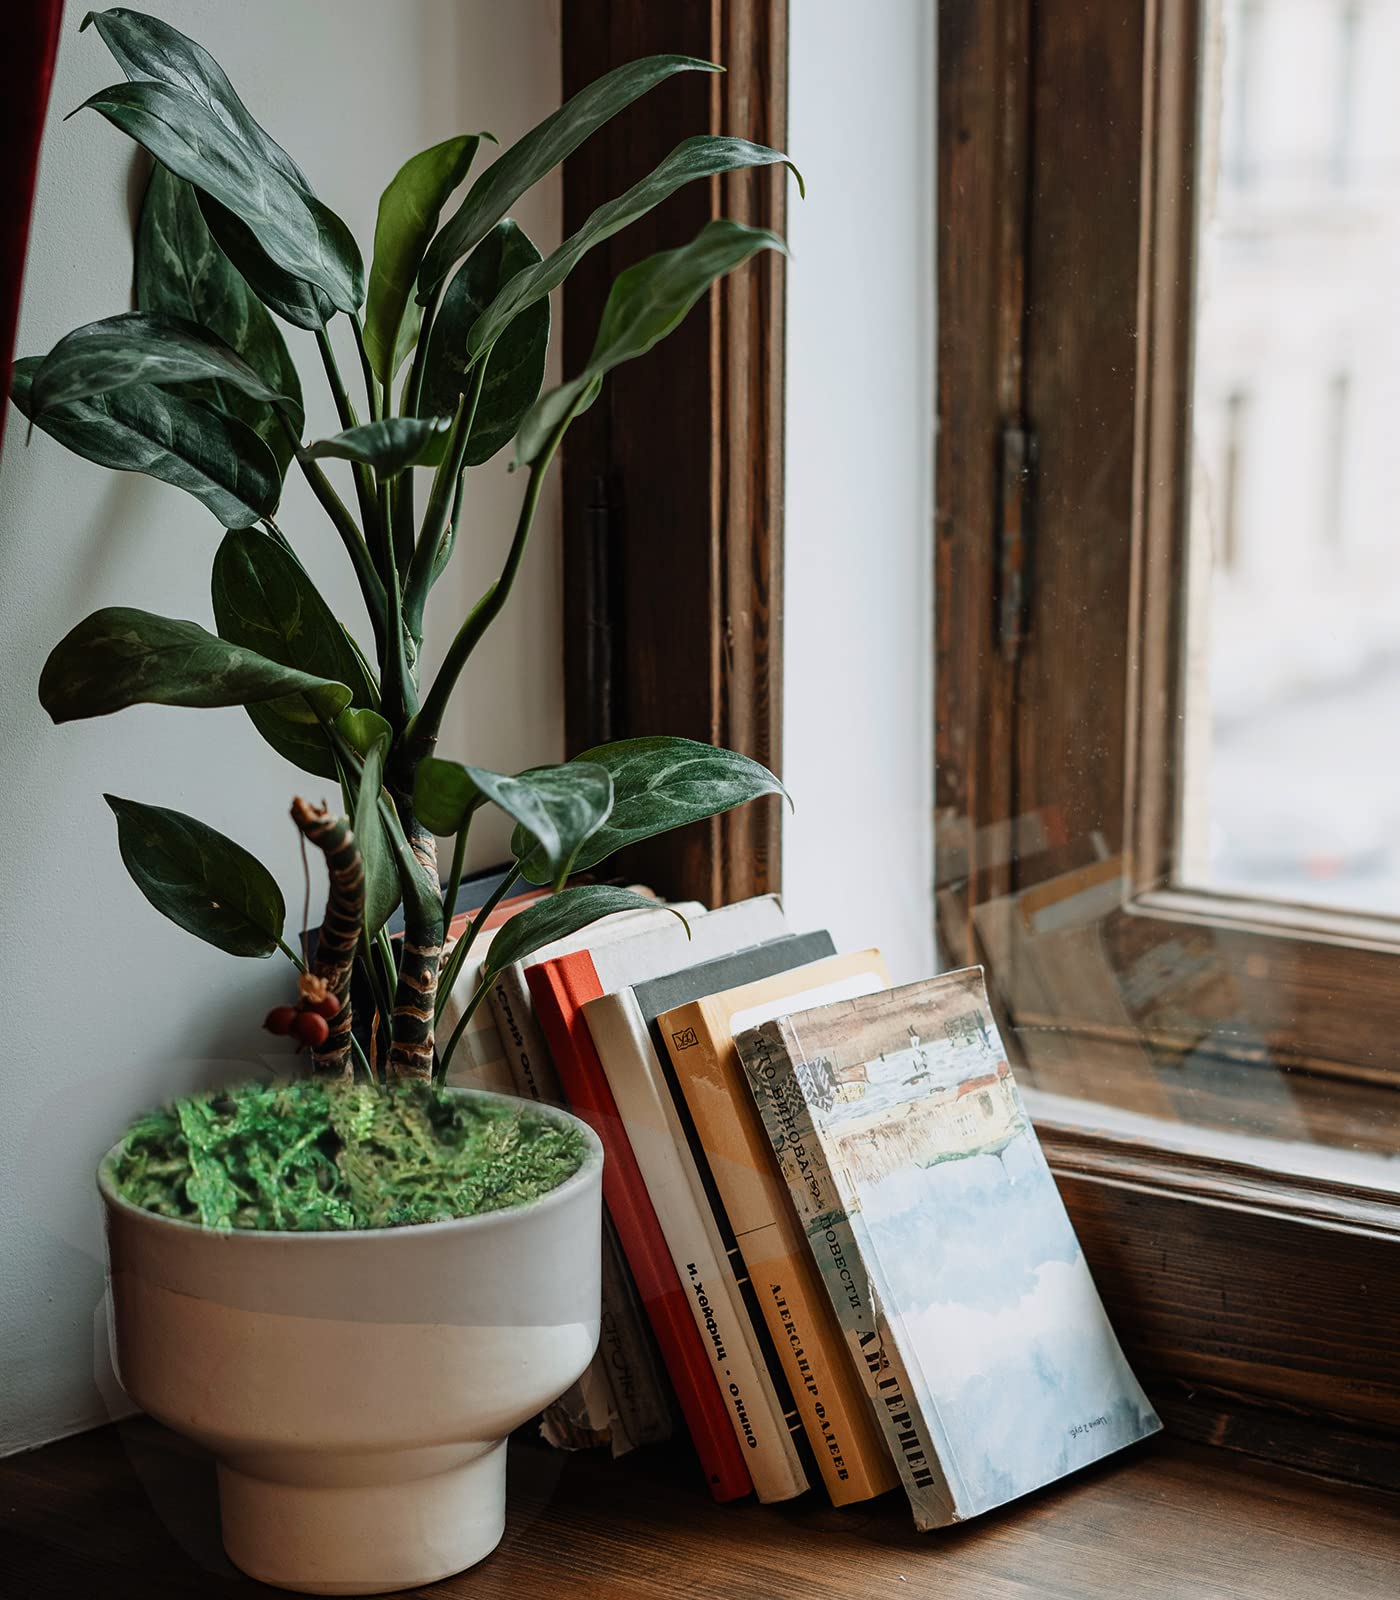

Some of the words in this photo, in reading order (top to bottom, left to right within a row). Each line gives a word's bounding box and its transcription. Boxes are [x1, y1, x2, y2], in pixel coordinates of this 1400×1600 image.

[520, 1052, 541, 1101] ОЛЕ
[754, 1039, 777, 1079] КТО
[820, 1215, 862, 1309] ПОВЕСТИ
[879, 1377, 935, 1489] ГЕРЦЕН
[769, 1284, 819, 1396] АЛЕКСАНДР
[815, 1401, 849, 1481] ФАДЕЕВ
